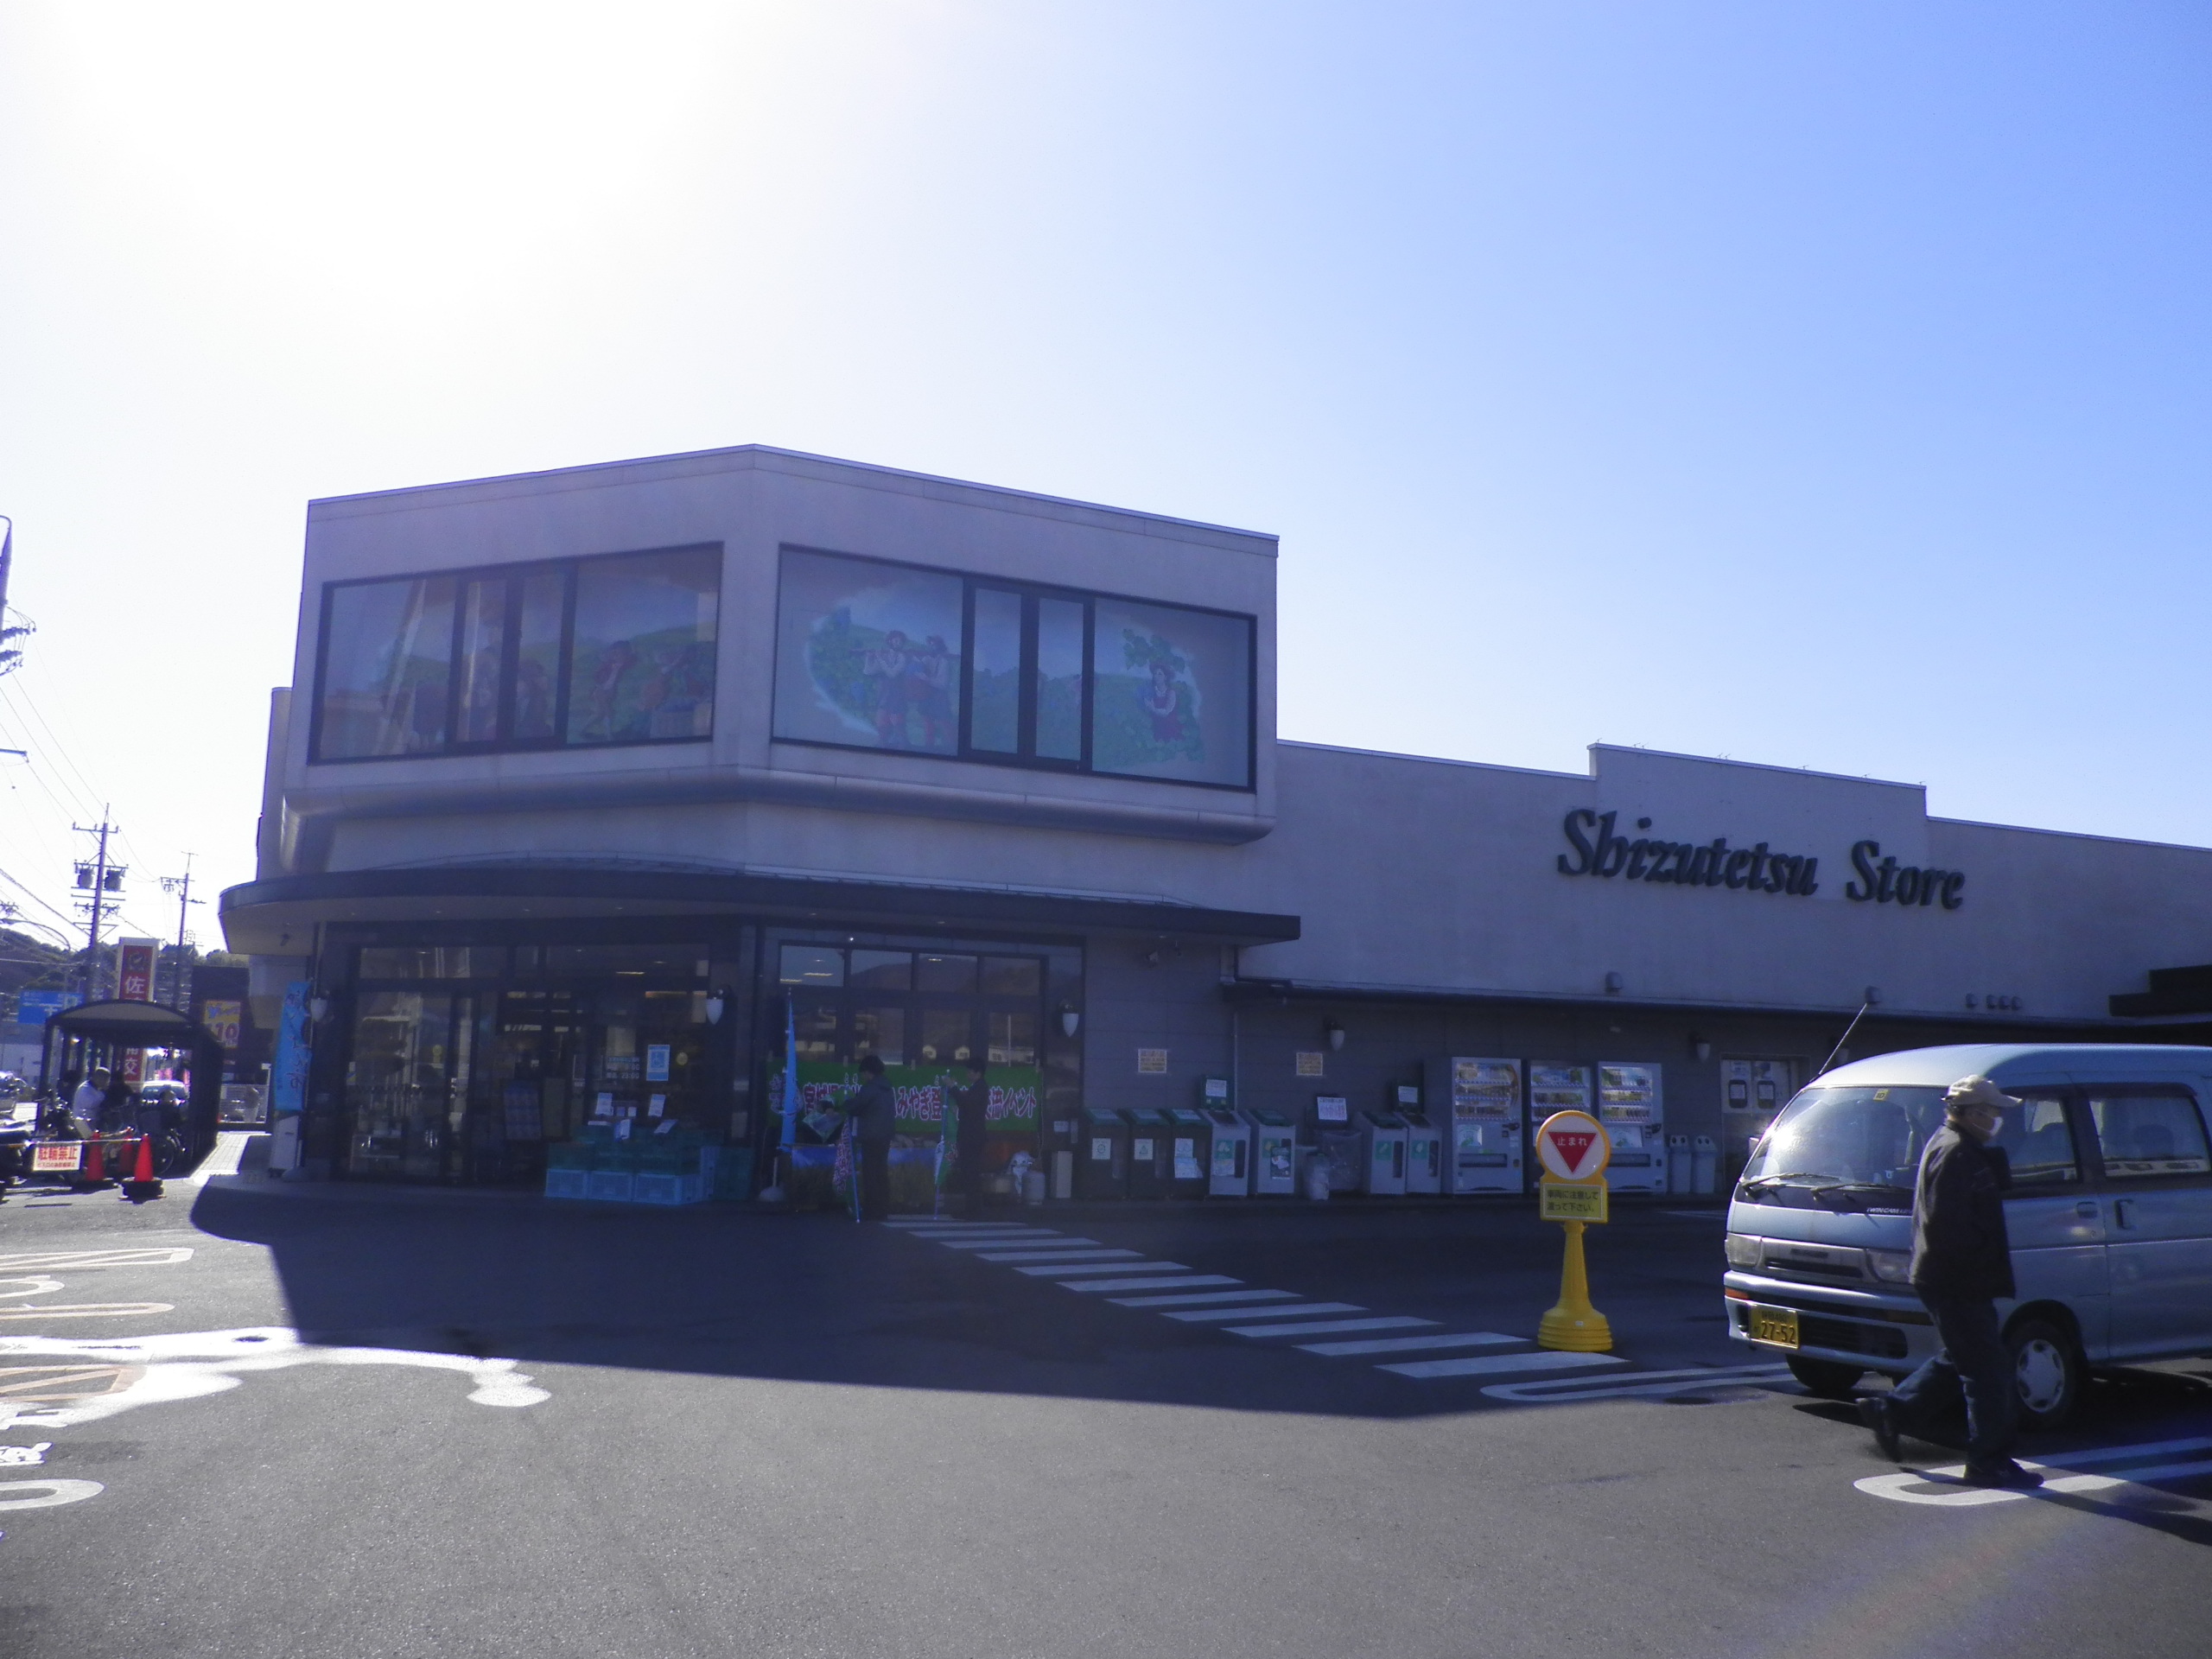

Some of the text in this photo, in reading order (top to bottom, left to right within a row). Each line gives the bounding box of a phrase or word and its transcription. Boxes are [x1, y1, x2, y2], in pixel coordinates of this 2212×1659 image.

[1556, 807, 1966, 911] Shizutetsu Store
[1556, 1137, 1587, 1146] 止まれ
[38, 1146, 78, 1160] 駐輪禁止
[1548, 1189, 1599, 1200] 車両に注意して
[1761, 1320, 1796, 1344] 27-52
